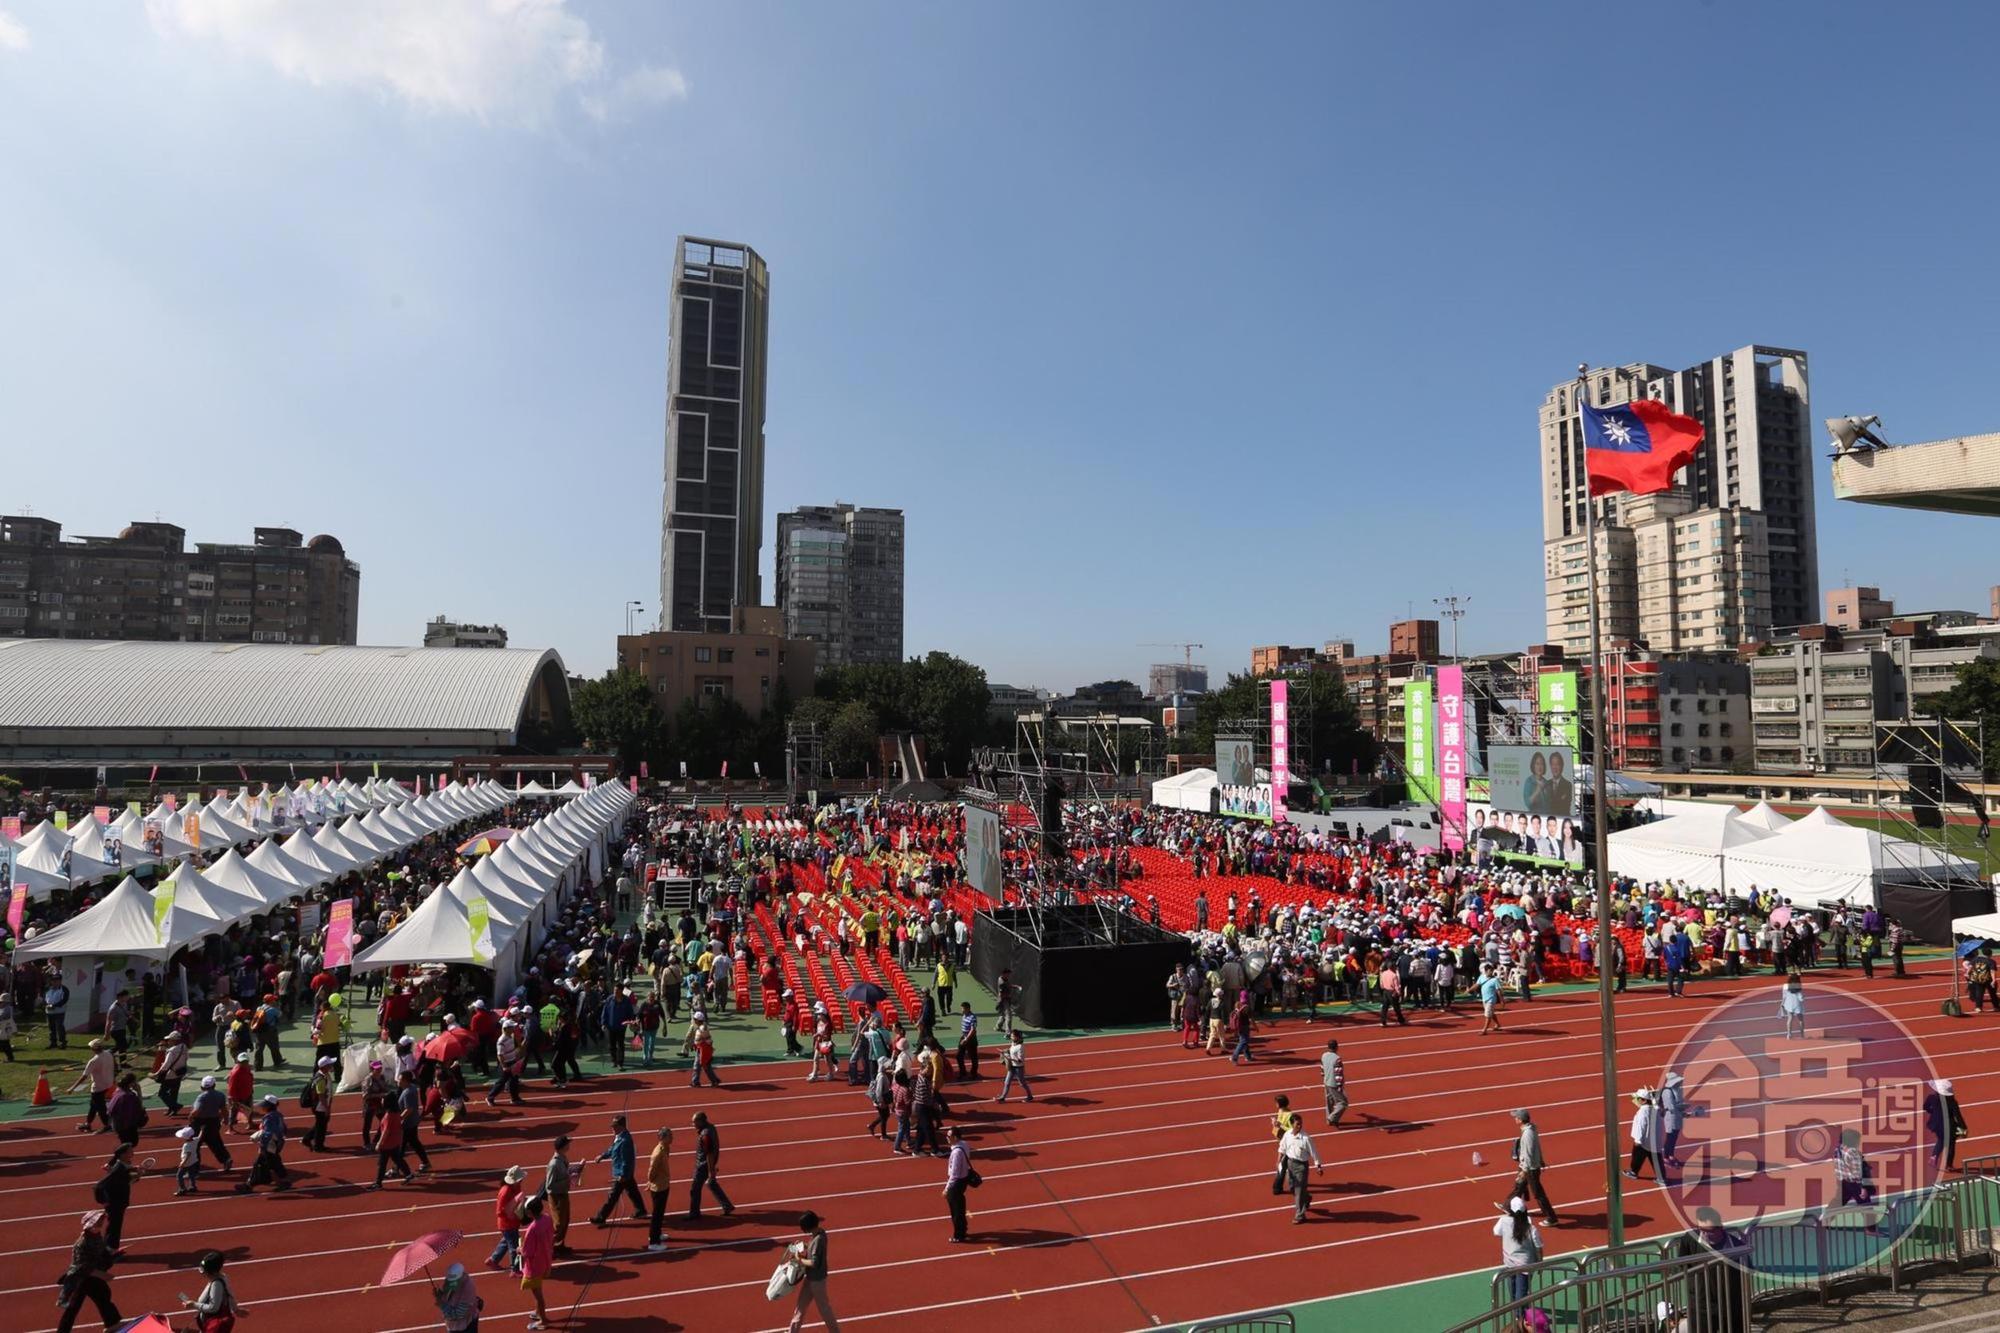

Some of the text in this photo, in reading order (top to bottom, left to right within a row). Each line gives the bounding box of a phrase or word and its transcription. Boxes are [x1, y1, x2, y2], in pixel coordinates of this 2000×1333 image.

[1273, 702, 1285, 788] 國會過半
[1442, 694, 1461, 804] 守護台灣
